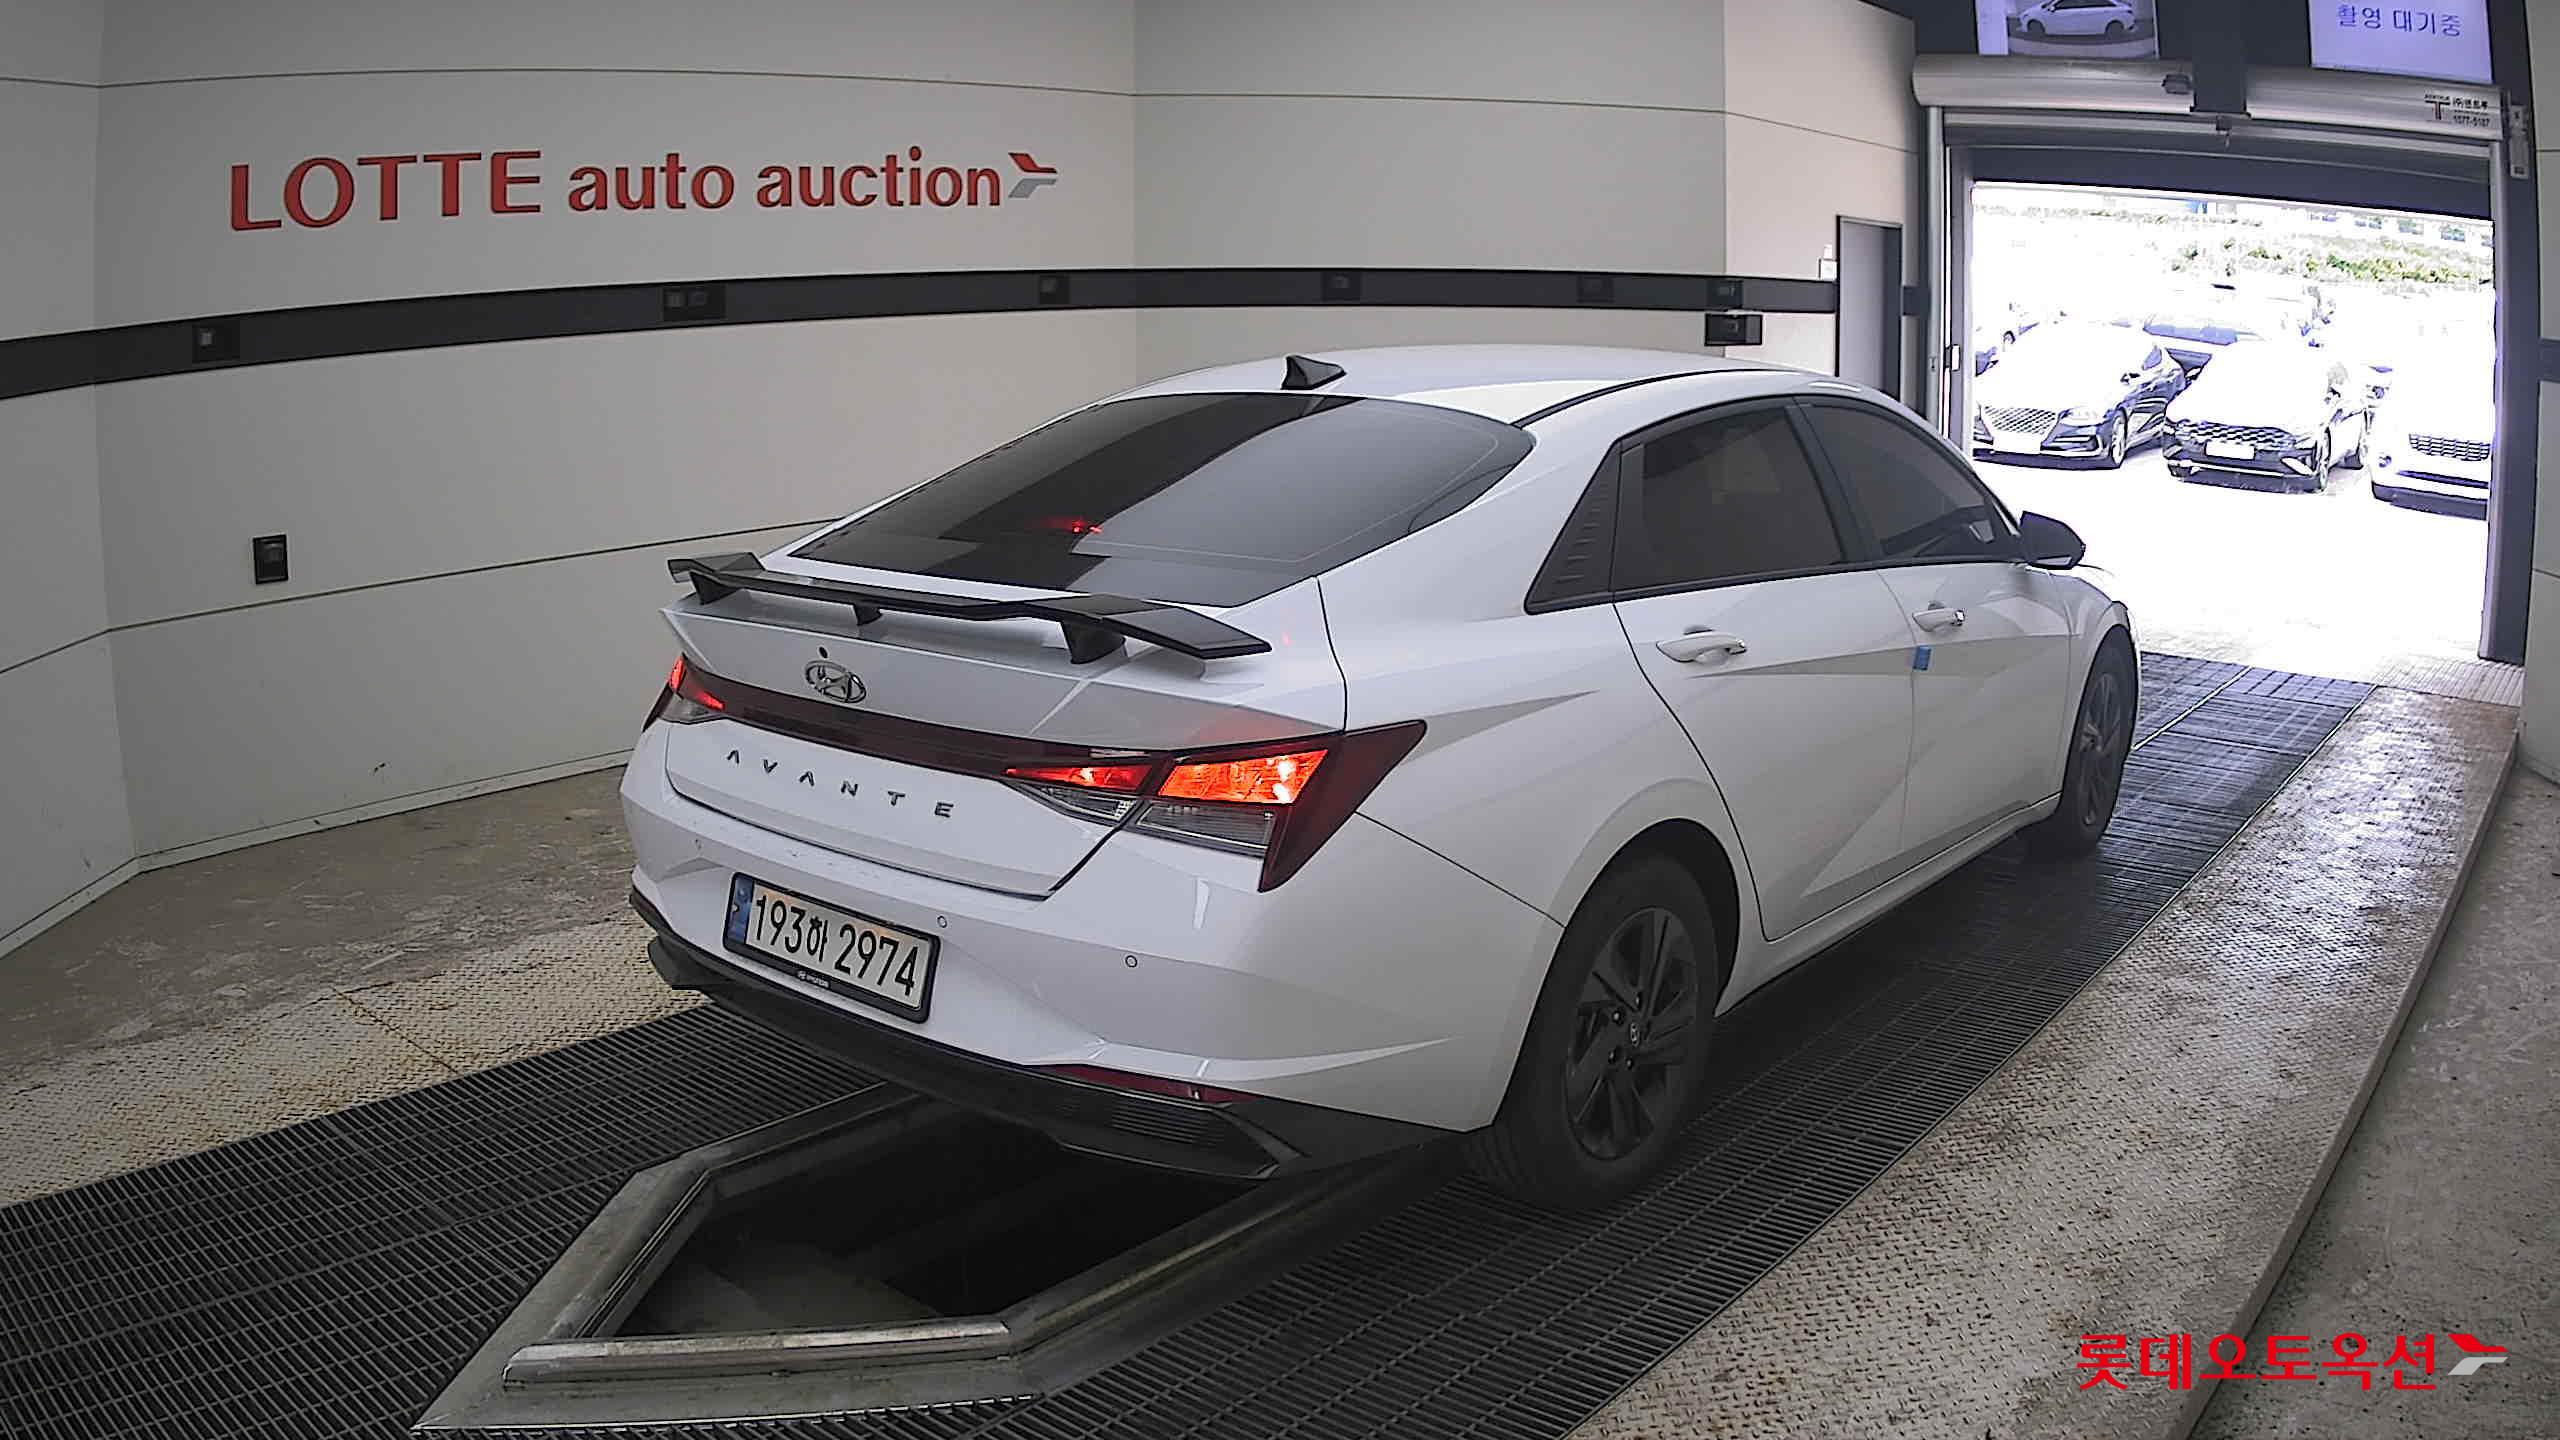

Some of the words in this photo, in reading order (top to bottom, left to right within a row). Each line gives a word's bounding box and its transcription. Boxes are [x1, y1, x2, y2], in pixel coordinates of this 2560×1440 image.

[2338, 4, 2382, 30] 촬영
[2393, 9, 2461, 37] 대기중
[231, 151, 542, 231] LOTTE
[568, 152, 735, 210] auto
[756, 146, 1001, 207] auction
[727, 749, 954, 818] AVANTE
[755, 894, 829, 962] 193하
[834, 923, 919, 997] 2974
